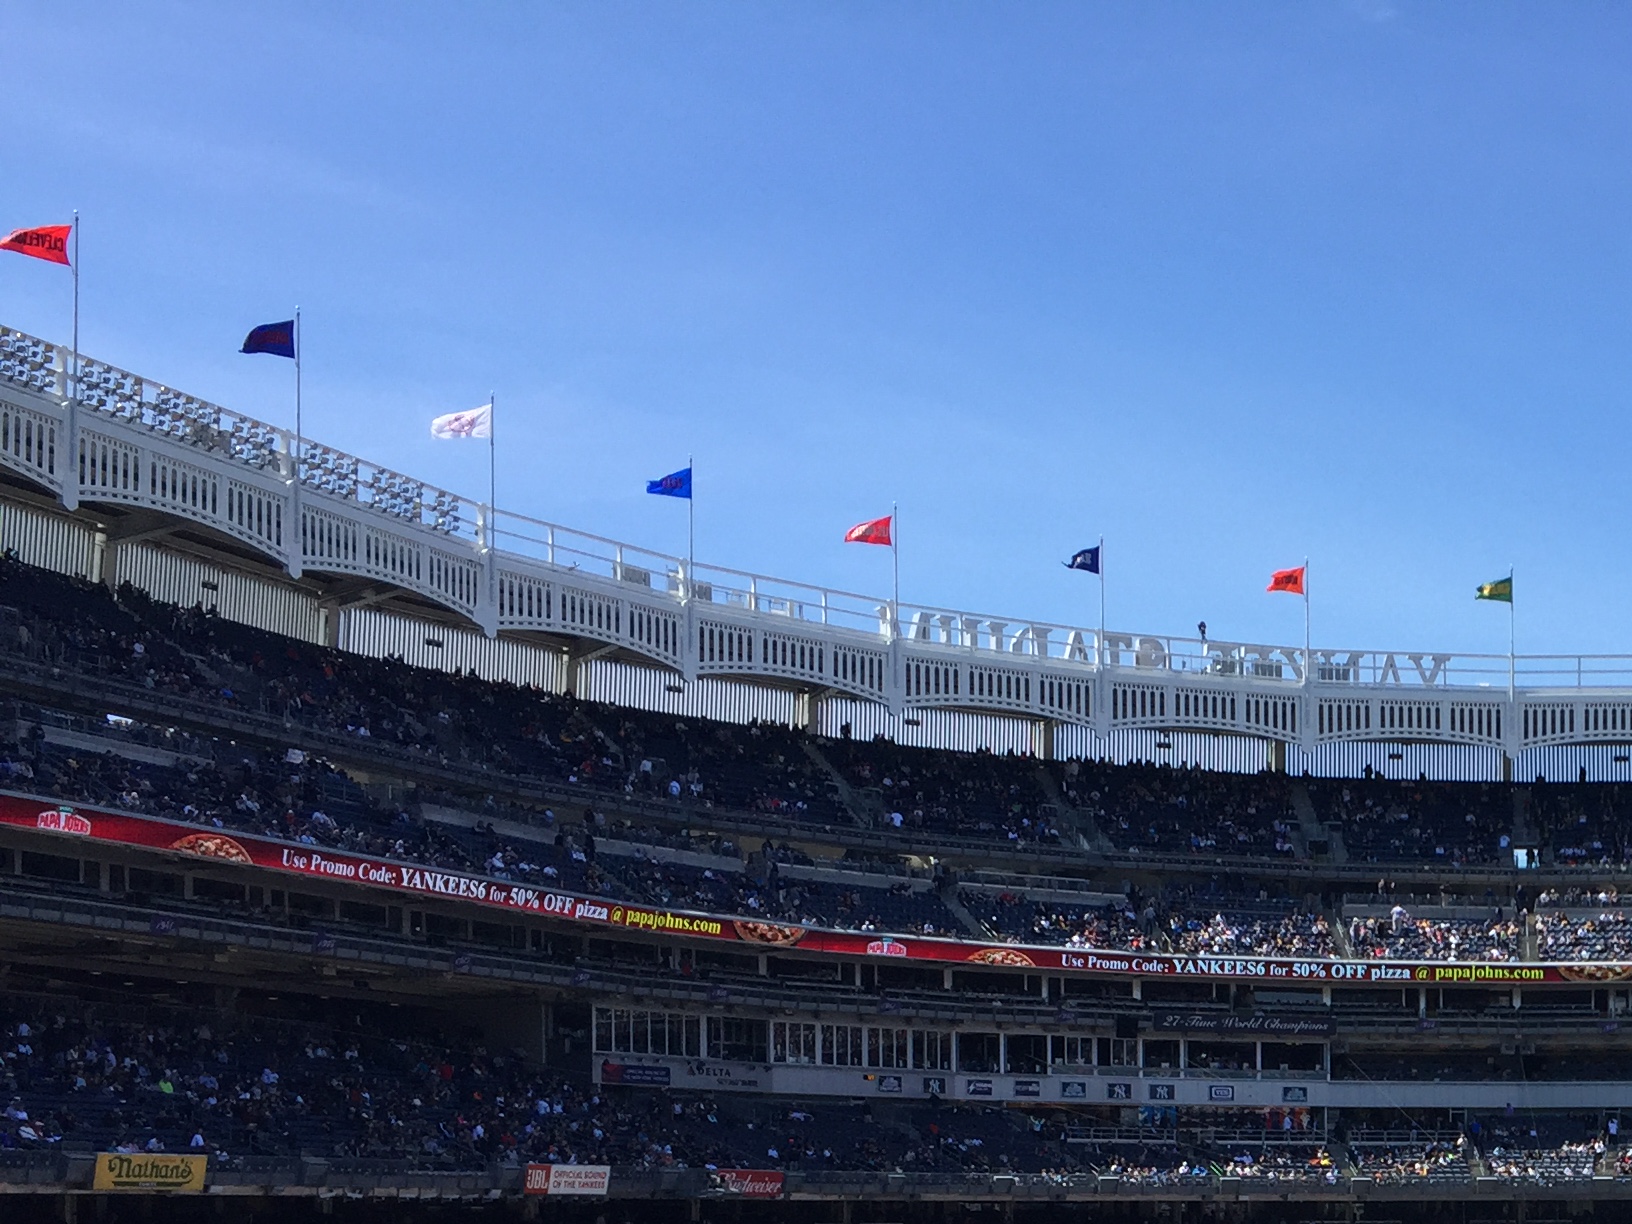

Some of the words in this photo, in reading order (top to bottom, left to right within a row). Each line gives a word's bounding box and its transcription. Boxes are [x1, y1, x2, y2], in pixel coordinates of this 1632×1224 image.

[283, 849, 307, 869] Use
[311, 854, 355, 877] Promo
[358, 863, 397, 884] Code:
[400, 867, 487, 900] YANKEES6
[489, 885, 507, 902] for
[509, 887, 540, 909] 50%
[543, 893, 574, 915] OFF
[576, 900, 608, 920] pizza
[610, 905, 624, 924] @
[626, 908, 721, 935] papajohns.com
[1061, 953, 1084, 968] Use
[1088, 956, 1129, 971] Promo
[1131, 958, 1169, 973] Code:
[1172, 959, 1266, 976] YANKEES6
[1270, 963, 1288, 976] for
[1292, 963, 1326, 978] 50%
[1331, 964, 1366, 979] OFF
[1371, 965, 1411, 981] pizza
[1415, 966, 1430, 981] @
[1435, 965, 1544, 981] papajohns.com
[1162, 1015, 1217, 1027] 27-Time
[1221, 1017, 1263, 1029] World
[1264, 1018, 1329, 1034] Champions
[698, 1066, 731, 1078] DELTA
[108, 1156, 194, 1179] Nathan's
[554, 1170, 583, 1179] OFFICIAL
[584, 1170, 606, 1180] SOUND
[527, 1168, 549, 1189] JBL
[553, 1179, 563, 1188] OF
[563, 1180, 576, 1188] THE
[578, 1180, 605, 1189] YANKEES
